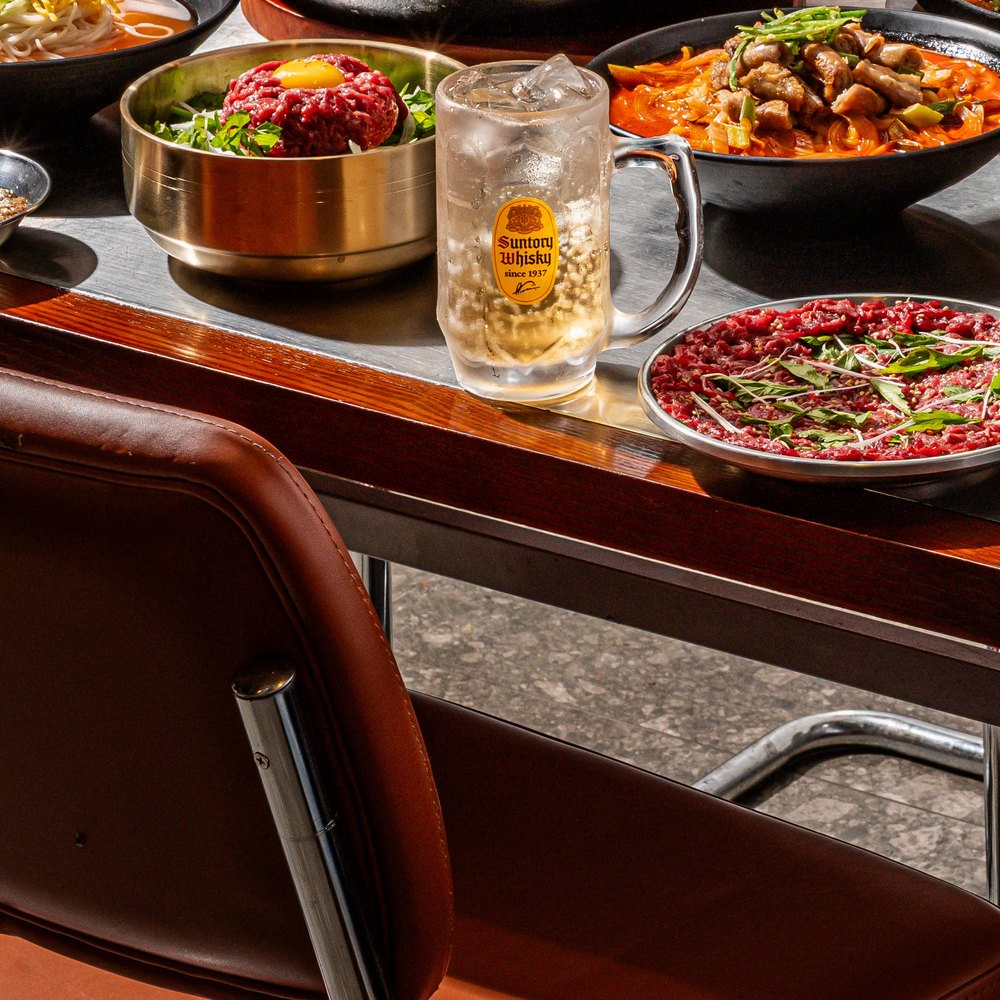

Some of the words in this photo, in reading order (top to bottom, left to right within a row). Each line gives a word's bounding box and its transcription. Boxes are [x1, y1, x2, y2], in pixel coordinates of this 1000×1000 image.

[498, 235, 553, 250] Suntory
[500, 251, 551, 267] Whisky
[504, 269, 526, 278] since
[528, 269, 547, 278] 1937
